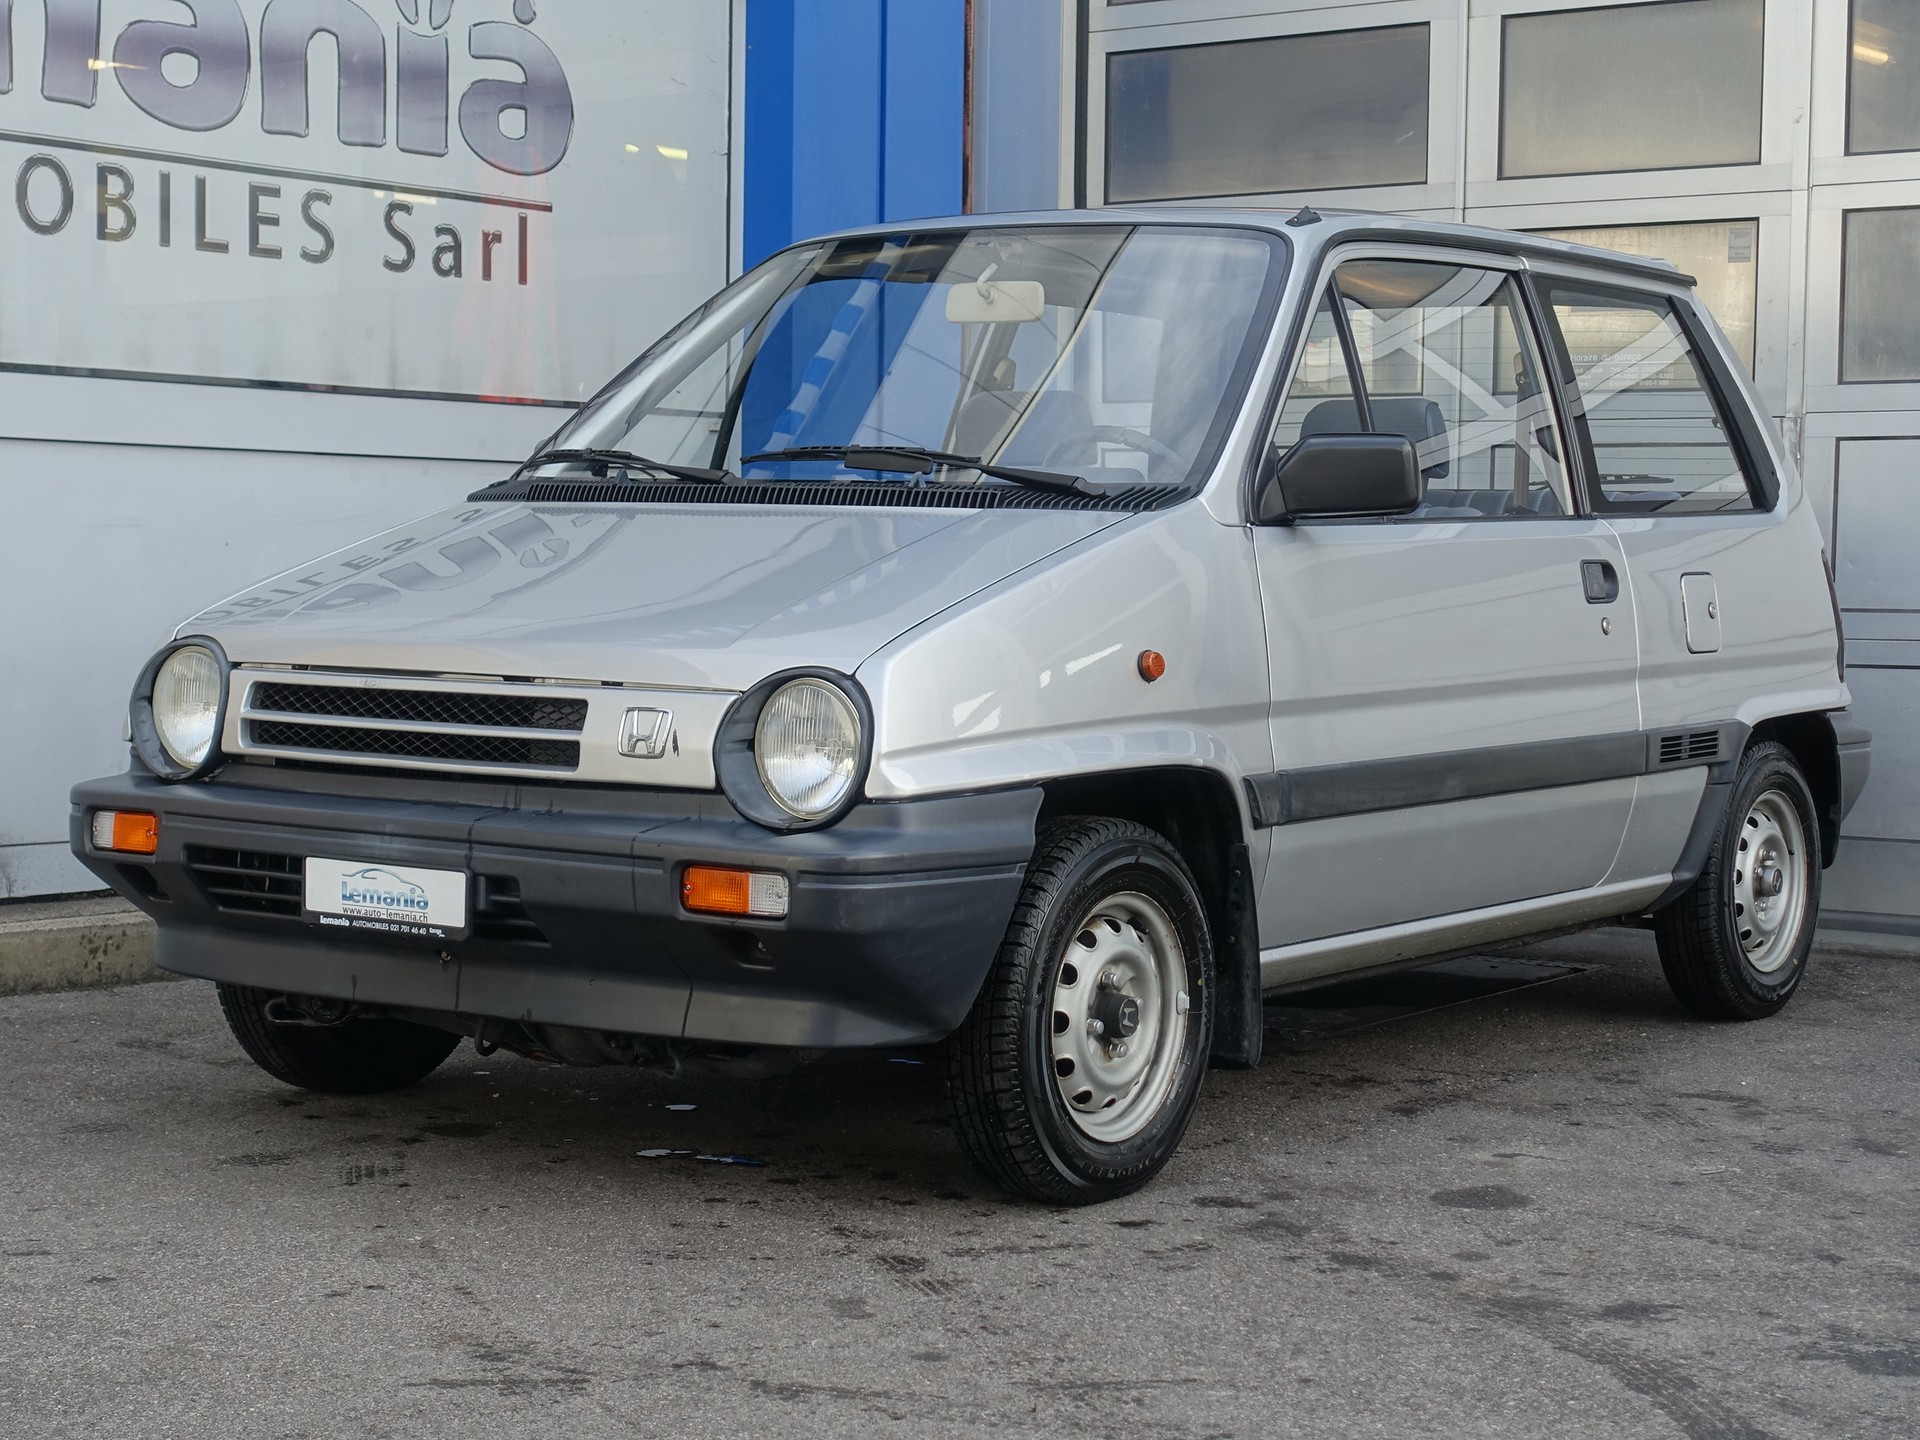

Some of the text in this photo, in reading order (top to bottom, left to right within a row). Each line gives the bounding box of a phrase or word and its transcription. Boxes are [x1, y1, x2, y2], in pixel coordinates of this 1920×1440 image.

[382, 200, 529, 286] Sarl
[1614, 353, 1642, 363] garage
[342, 881, 429, 910] Lemania
[342, 906, 428, 922] www.auto-lemania.ch
[352, 920, 389, 931] AUTOMOBILES
[390, 923, 400, 932] 021
[400, 925, 410, 933] 701
[419, 927, 427, 935] 40
